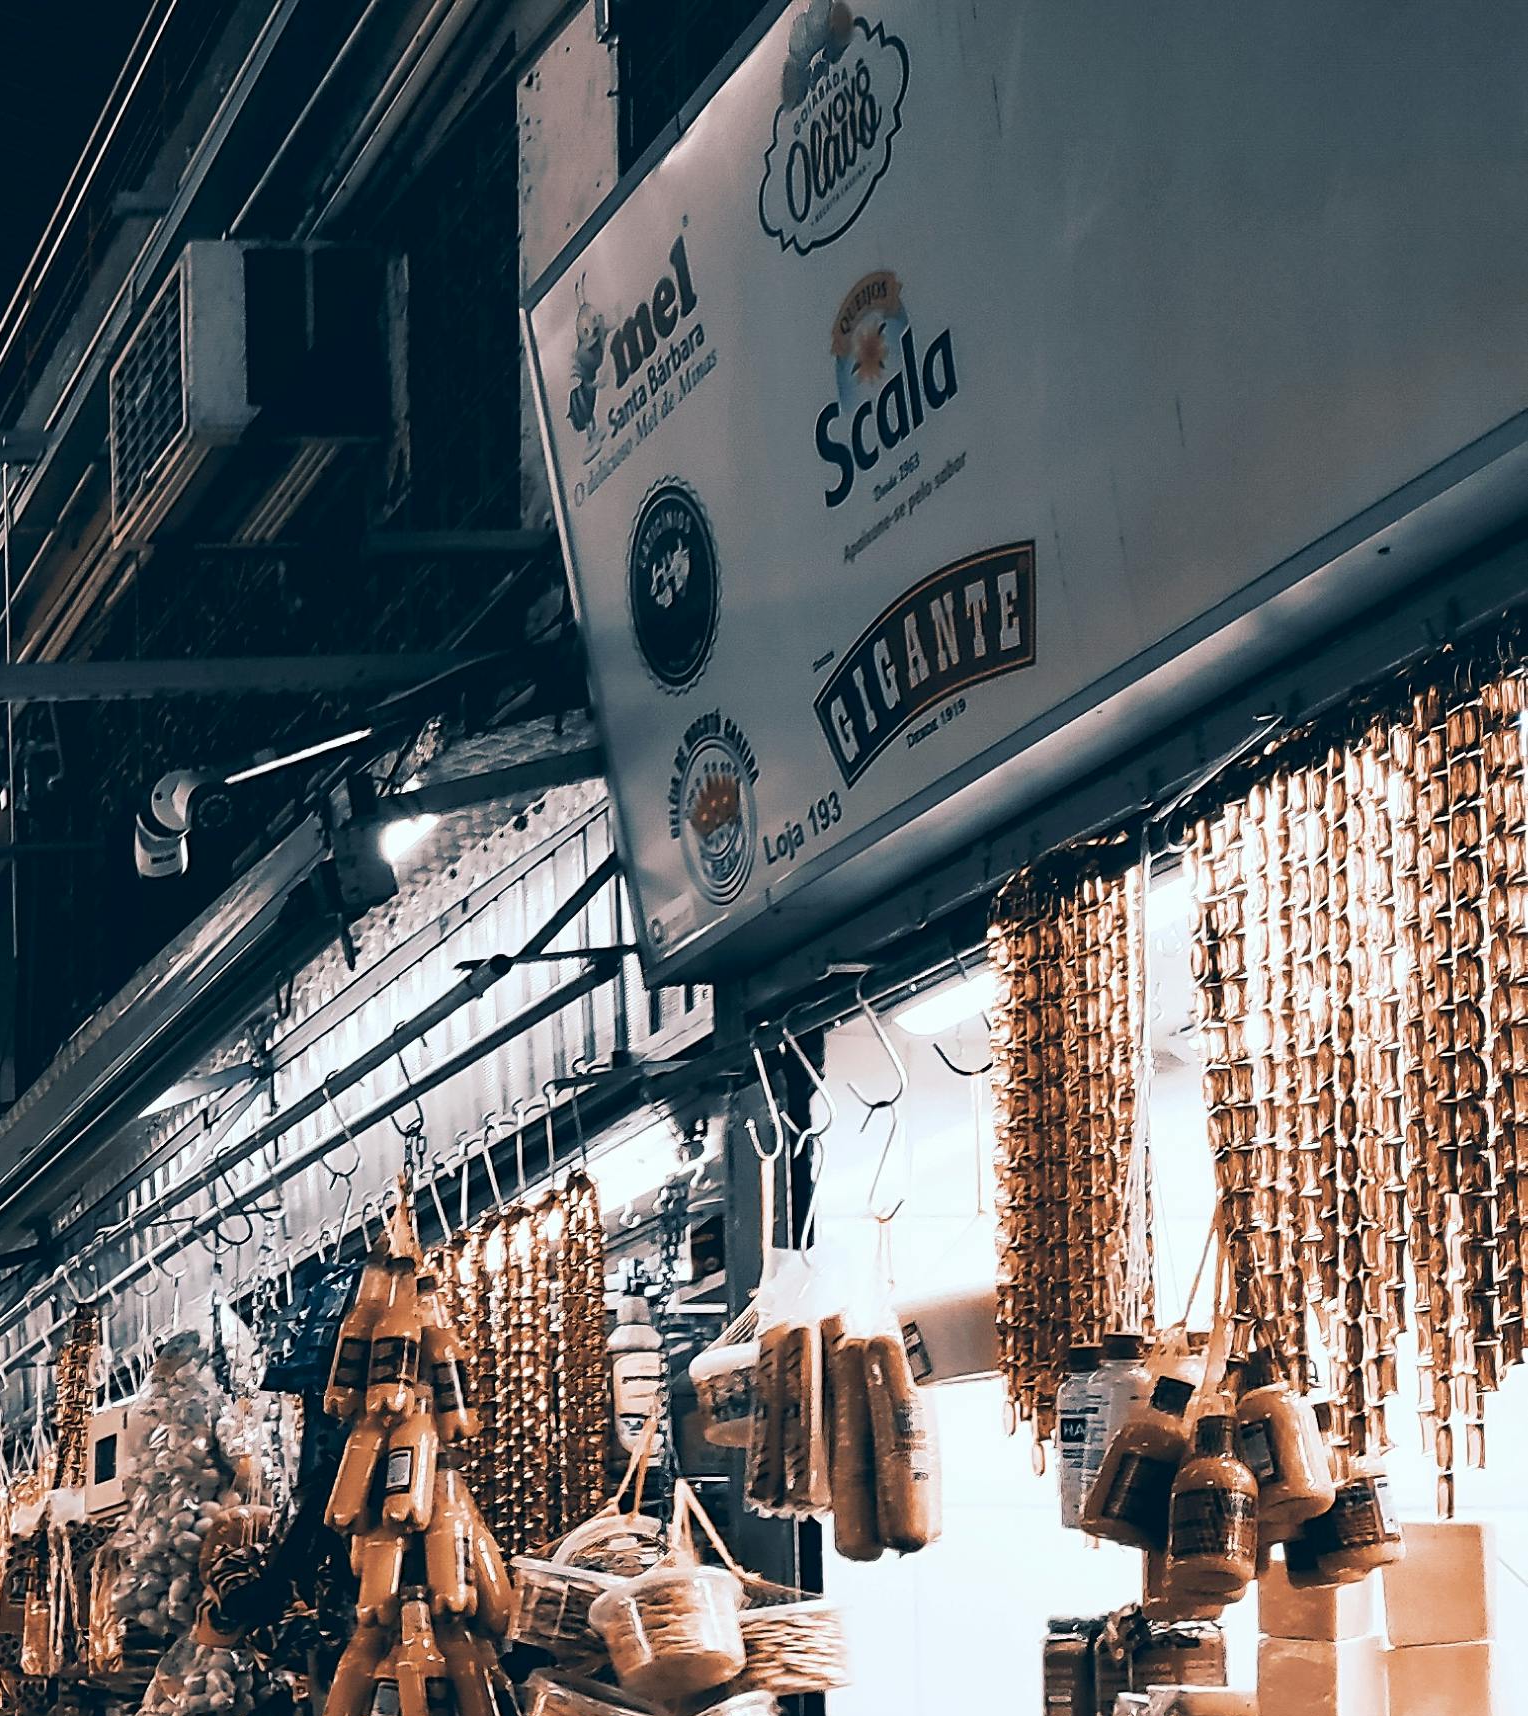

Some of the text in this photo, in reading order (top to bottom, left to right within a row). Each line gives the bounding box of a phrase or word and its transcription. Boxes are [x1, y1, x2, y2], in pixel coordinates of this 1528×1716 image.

[610, 234, 697, 389] mel
[840, 279, 888, 335] QUEIJOS
[608, 323, 705, 439] Santa Bárbara
[815, 326, 958, 508] Scala
[830, 570, 1020, 763] GIGANTE
[762, 822, 804, 865] Loja
[807, 791, 842, 836] 193
